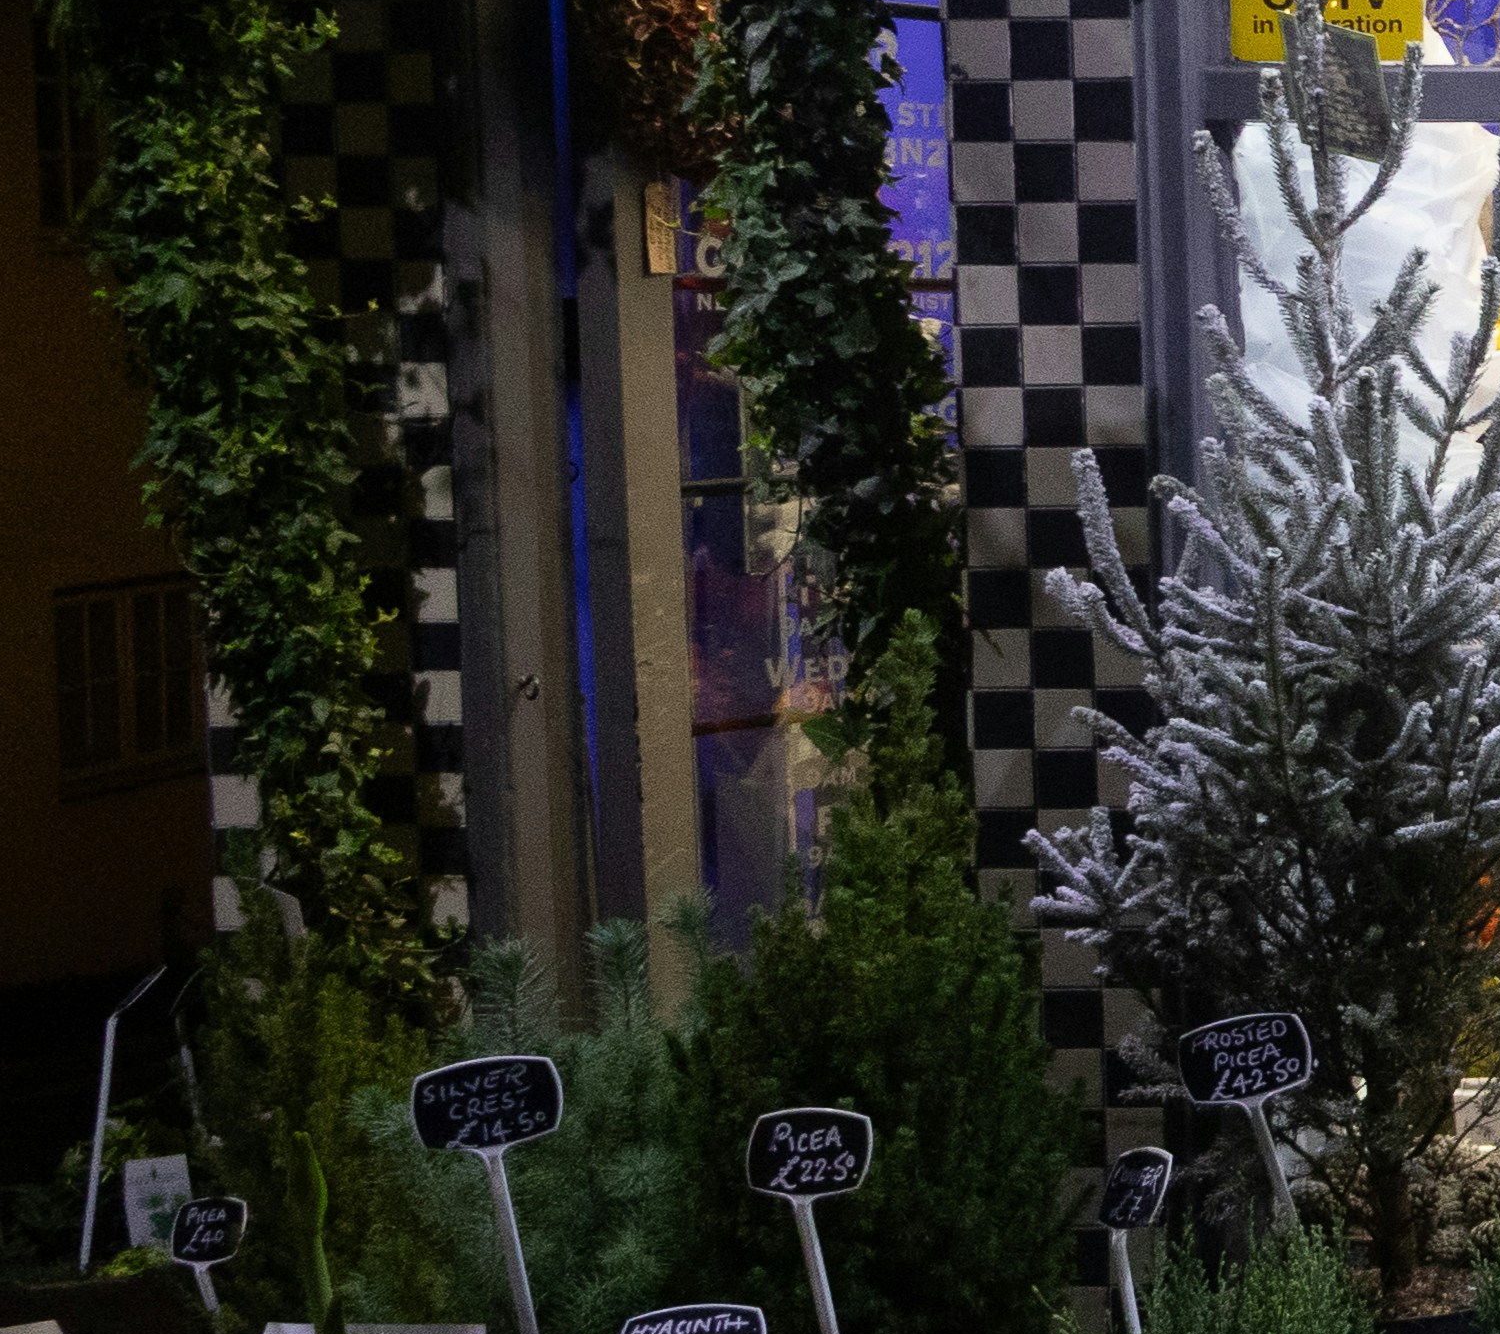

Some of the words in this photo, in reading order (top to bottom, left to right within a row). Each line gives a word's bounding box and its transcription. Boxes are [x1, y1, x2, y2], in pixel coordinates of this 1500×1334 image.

[1253, 15, 1274, 34] in
[1191, 1019, 1287, 1054] FROSTED
[1214, 1042, 1281, 1072] PICEA
[422, 1063, 527, 1104] SILVER
[450, 1085, 531, 1119] CREST
[768, 1122, 842, 1153] PICEA
[185, 1206, 227, 1227] PICEA
